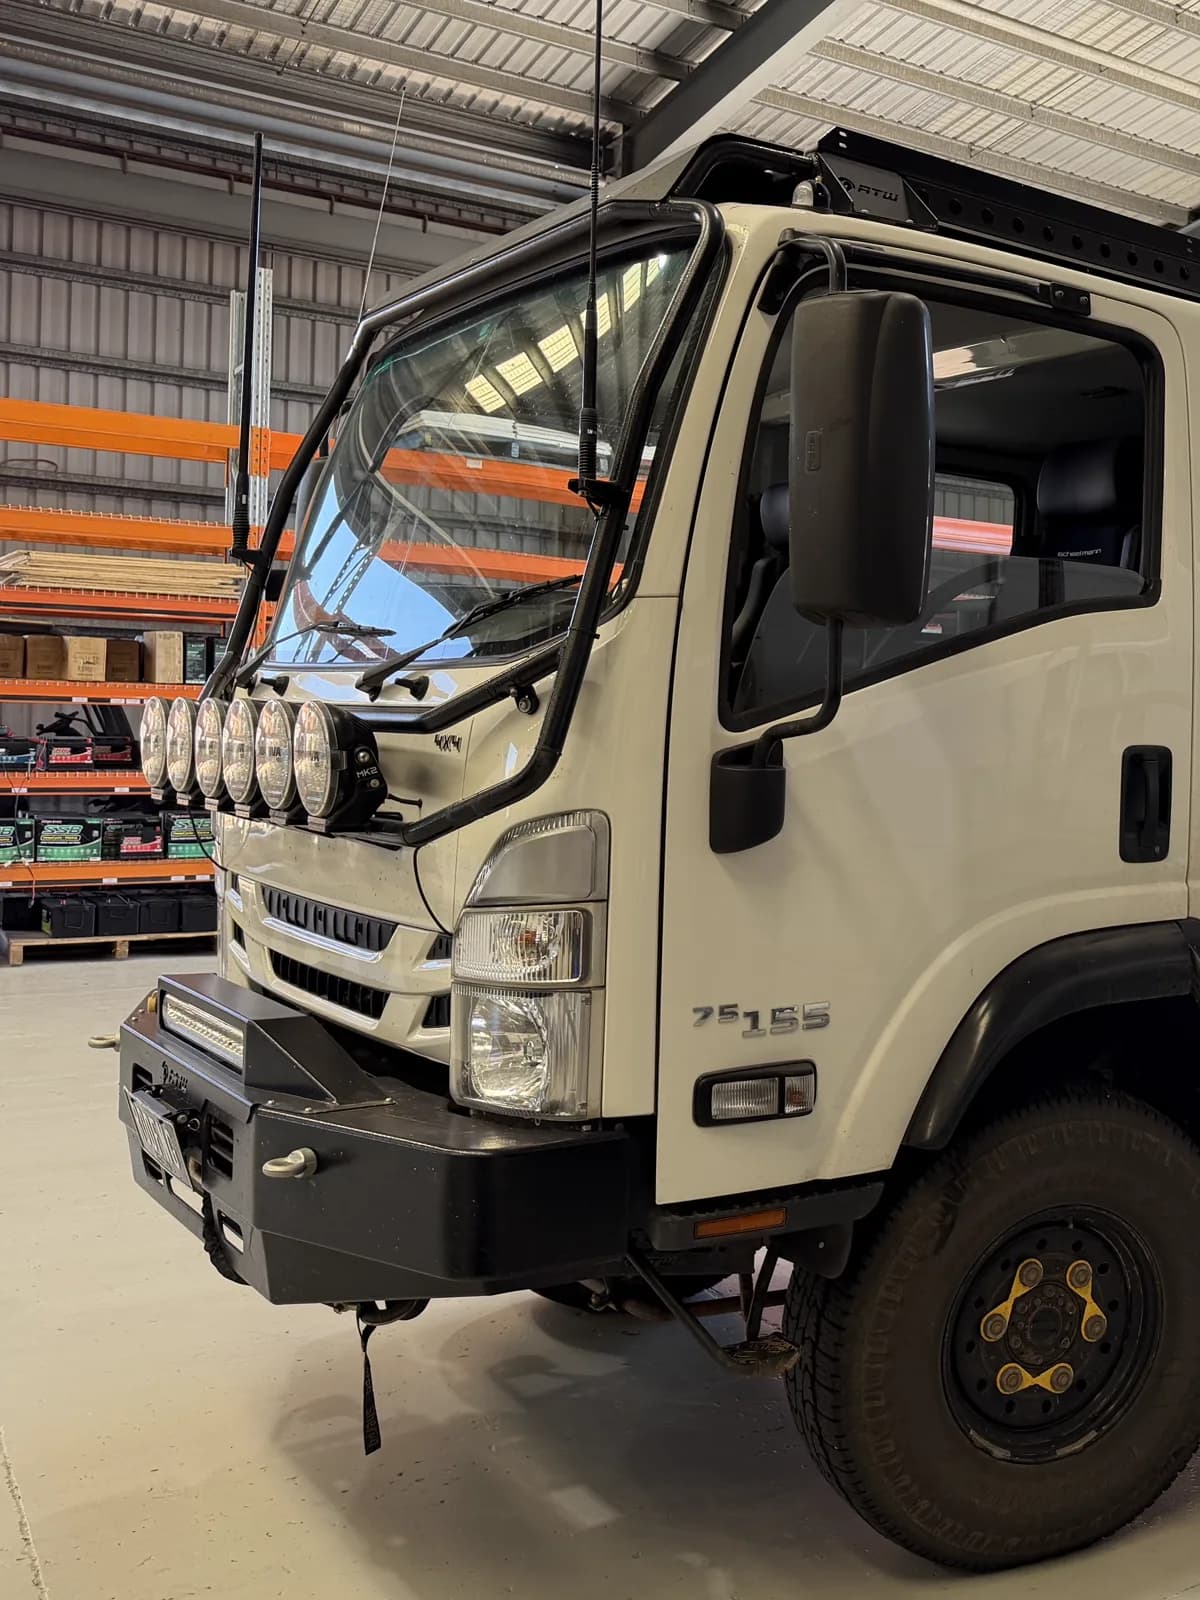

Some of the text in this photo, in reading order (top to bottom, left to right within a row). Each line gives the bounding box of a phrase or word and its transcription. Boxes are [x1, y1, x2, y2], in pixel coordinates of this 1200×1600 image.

[434, 734, 463, 753] 4X4
[355, 765, 379, 779] MK2
[41, 824, 84, 834] SSB
[691, 1000, 831, 1039] 75 155
